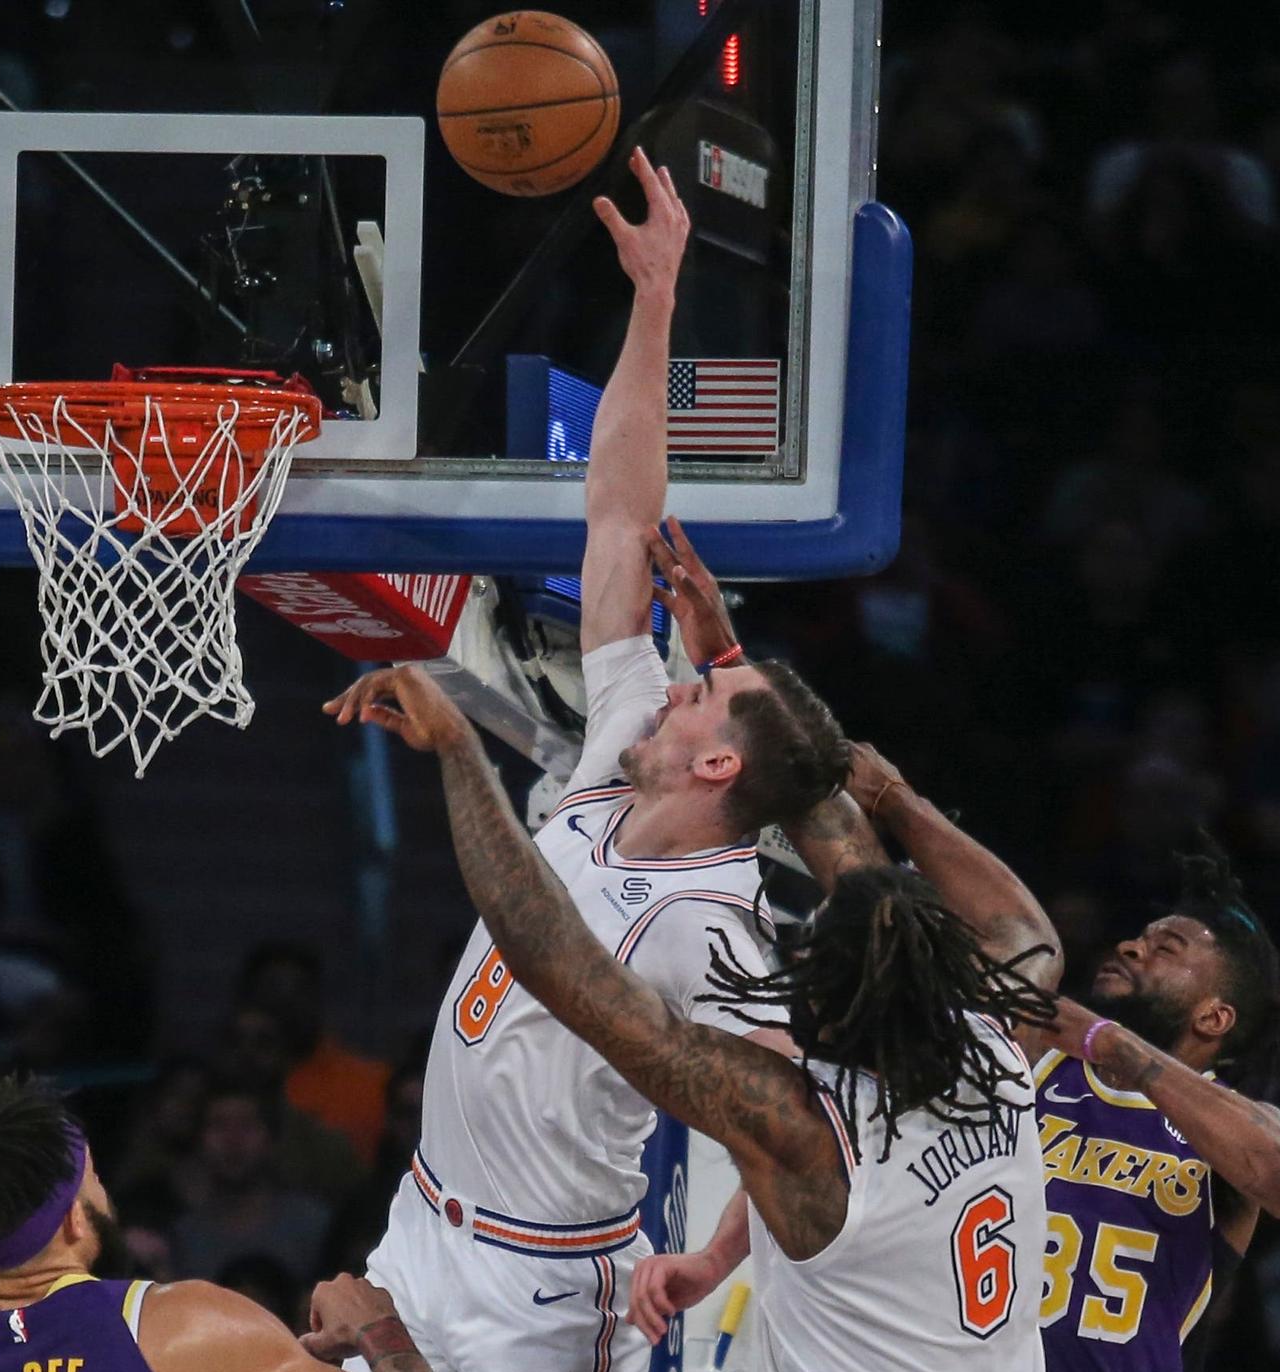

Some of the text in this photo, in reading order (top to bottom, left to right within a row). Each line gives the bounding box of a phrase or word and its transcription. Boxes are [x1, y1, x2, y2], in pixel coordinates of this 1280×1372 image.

[453, 943, 516, 1048] 8
[906, 1107, 1020, 1207] JORDAN
[950, 1184, 1018, 1340] 6
